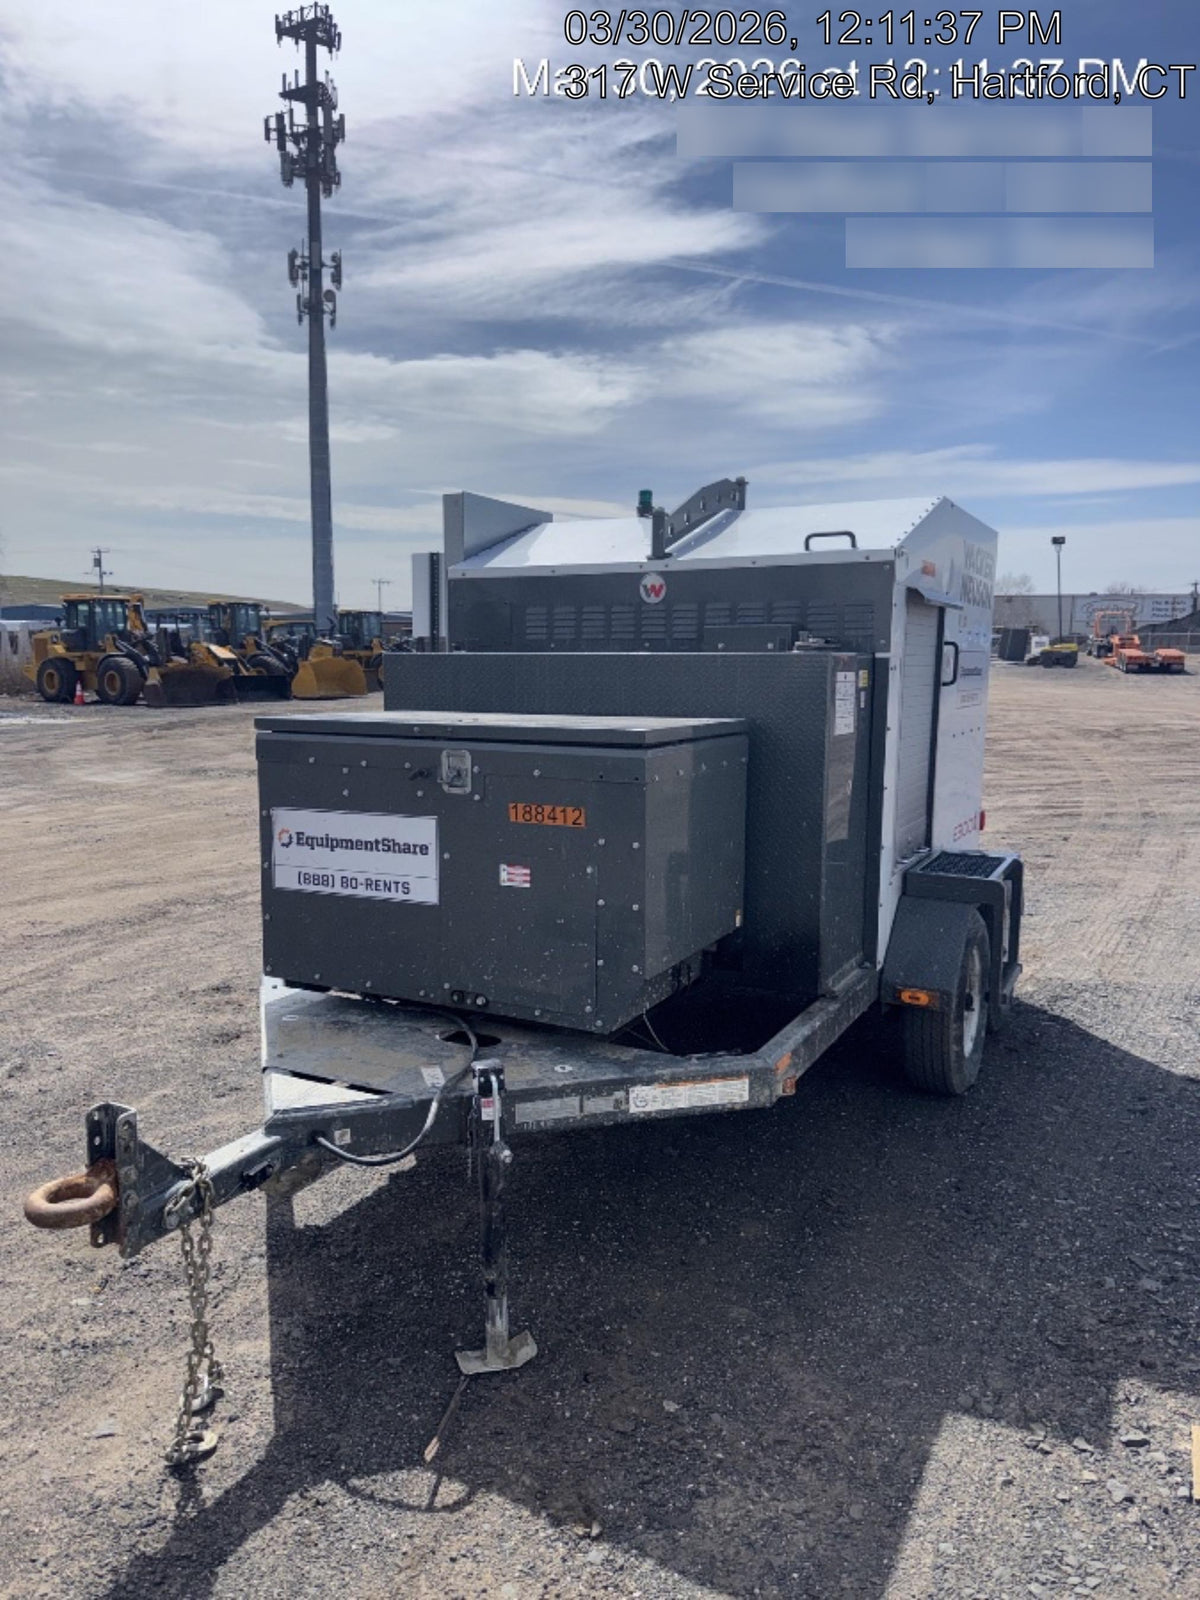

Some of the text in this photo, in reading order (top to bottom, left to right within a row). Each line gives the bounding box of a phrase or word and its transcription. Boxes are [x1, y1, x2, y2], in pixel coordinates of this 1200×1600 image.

[510, 803, 583, 826] 188412
[295, 831, 430, 856] EquipmentShare
[297, 870, 335, 888] (888)
